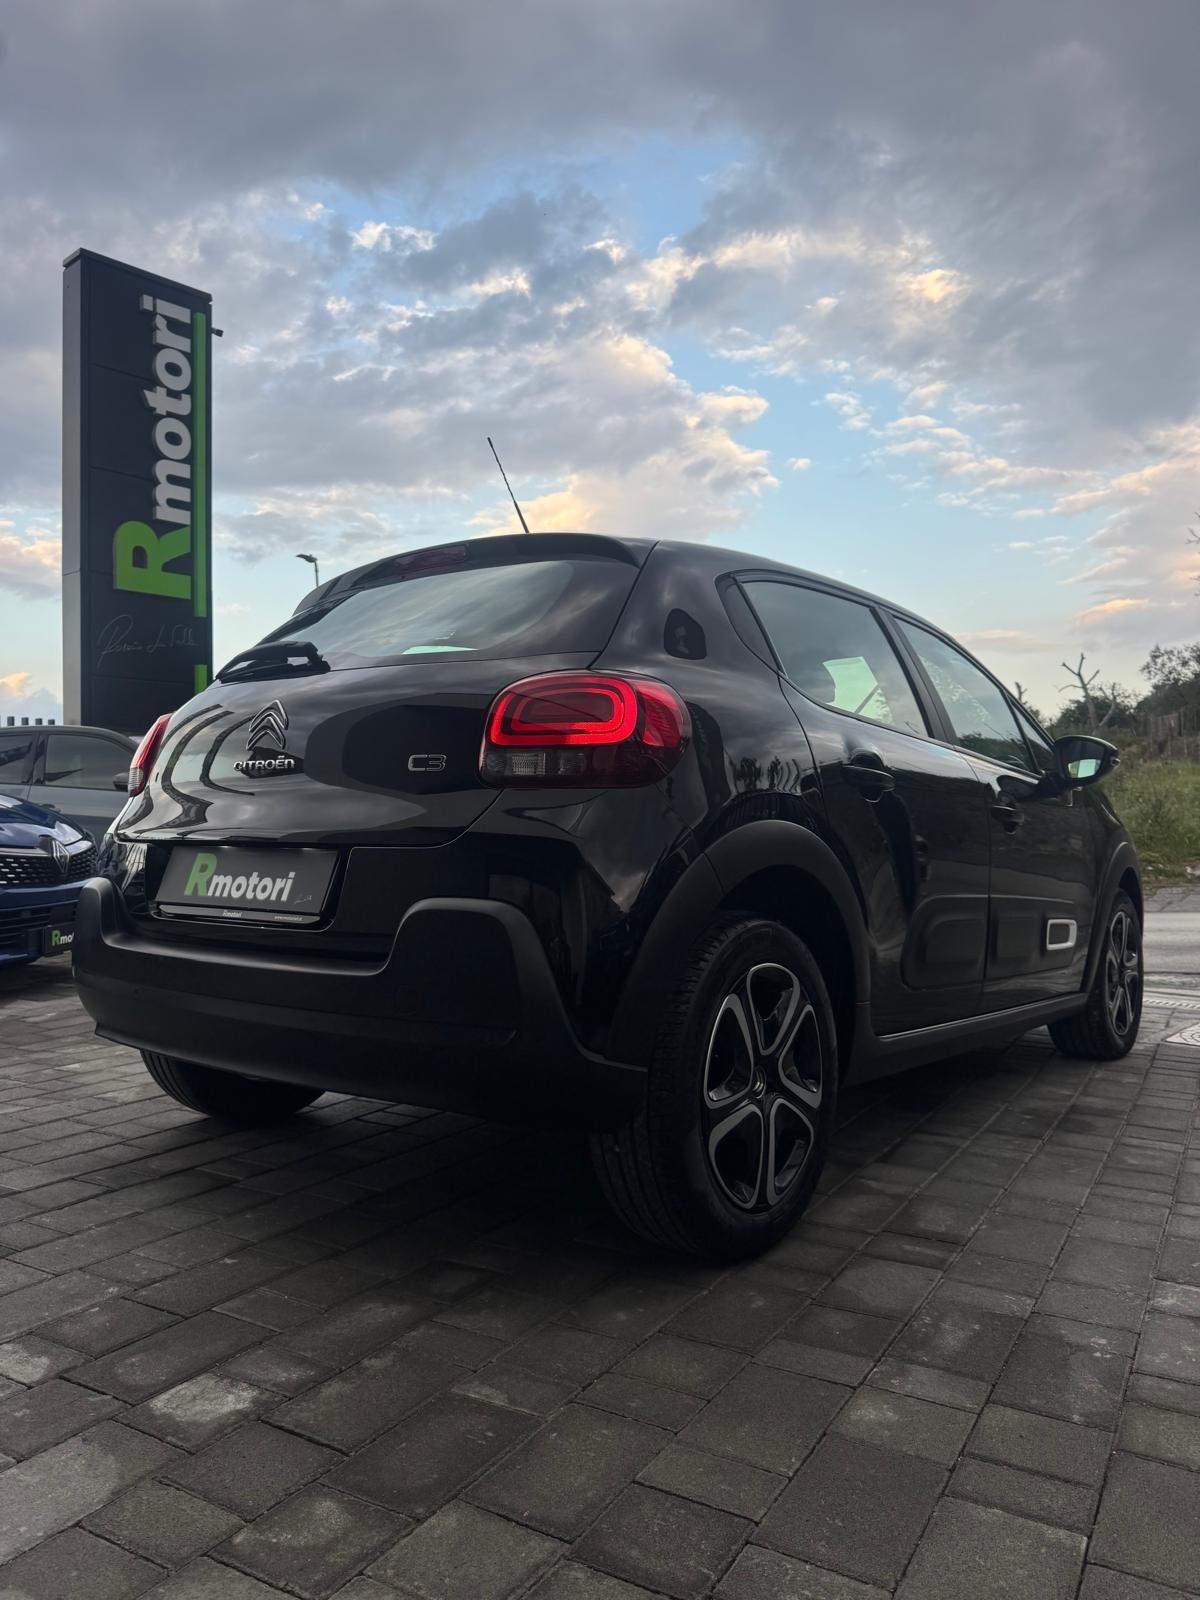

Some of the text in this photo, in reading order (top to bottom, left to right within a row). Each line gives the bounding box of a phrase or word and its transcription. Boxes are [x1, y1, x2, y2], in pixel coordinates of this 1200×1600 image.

[113, 294, 192, 599] Rmotori
[233, 755, 295, 770] CITROËN
[408, 754, 447, 771] C3
[184, 852, 296, 902] Rmotori
[52, 930, 74, 946] Rmo
